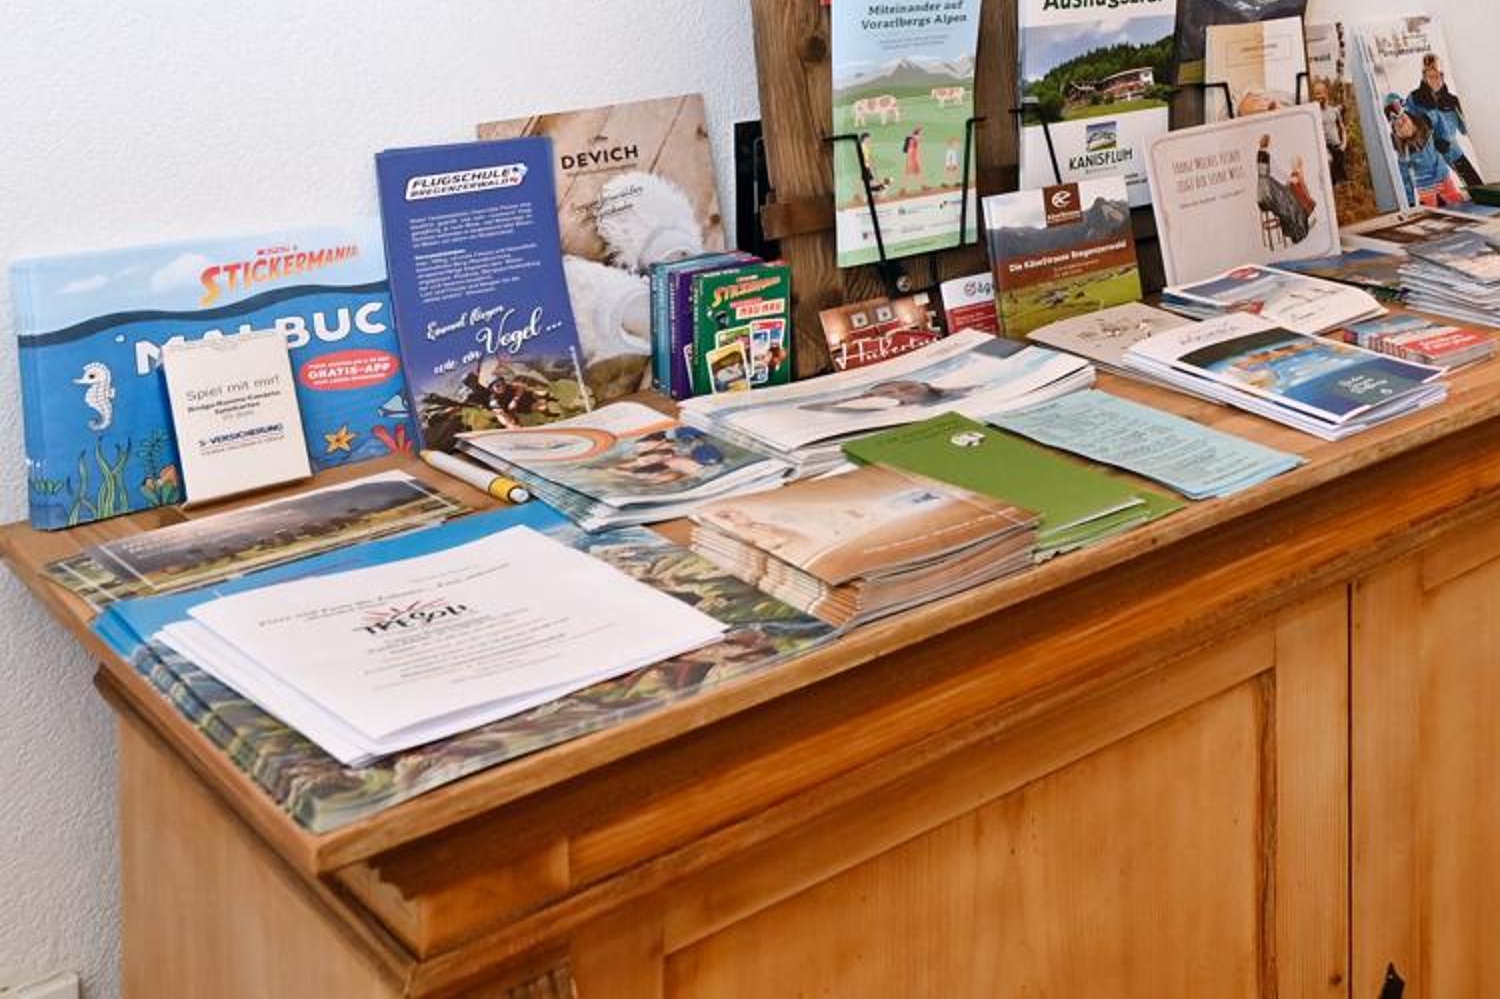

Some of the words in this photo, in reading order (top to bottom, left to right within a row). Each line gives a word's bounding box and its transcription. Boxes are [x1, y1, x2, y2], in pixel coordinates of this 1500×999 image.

[868, 2, 942, 16] Miteinander
[944, 0, 964, 10] auf
[861, 15, 931, 30] Vorarlbergs
[934, 13, 967, 26] Alpen
[561, 145, 639, 170] DEVICH
[1069, 148, 1133, 170] KANISFLUH
[410, 178, 513, 198] BREGENZERWALD
[411, 166, 514, 189] FLUGSCHULE
[199, 244, 361, 307] STICKERMANIA
[426, 312, 469, 341] Einmal
[476, 306, 544, 354] Vogel
[307, 362, 391, 380] GRATIS-APP
[186, 385, 223, 402] Spiel
[227, 380, 249, 393] mit
